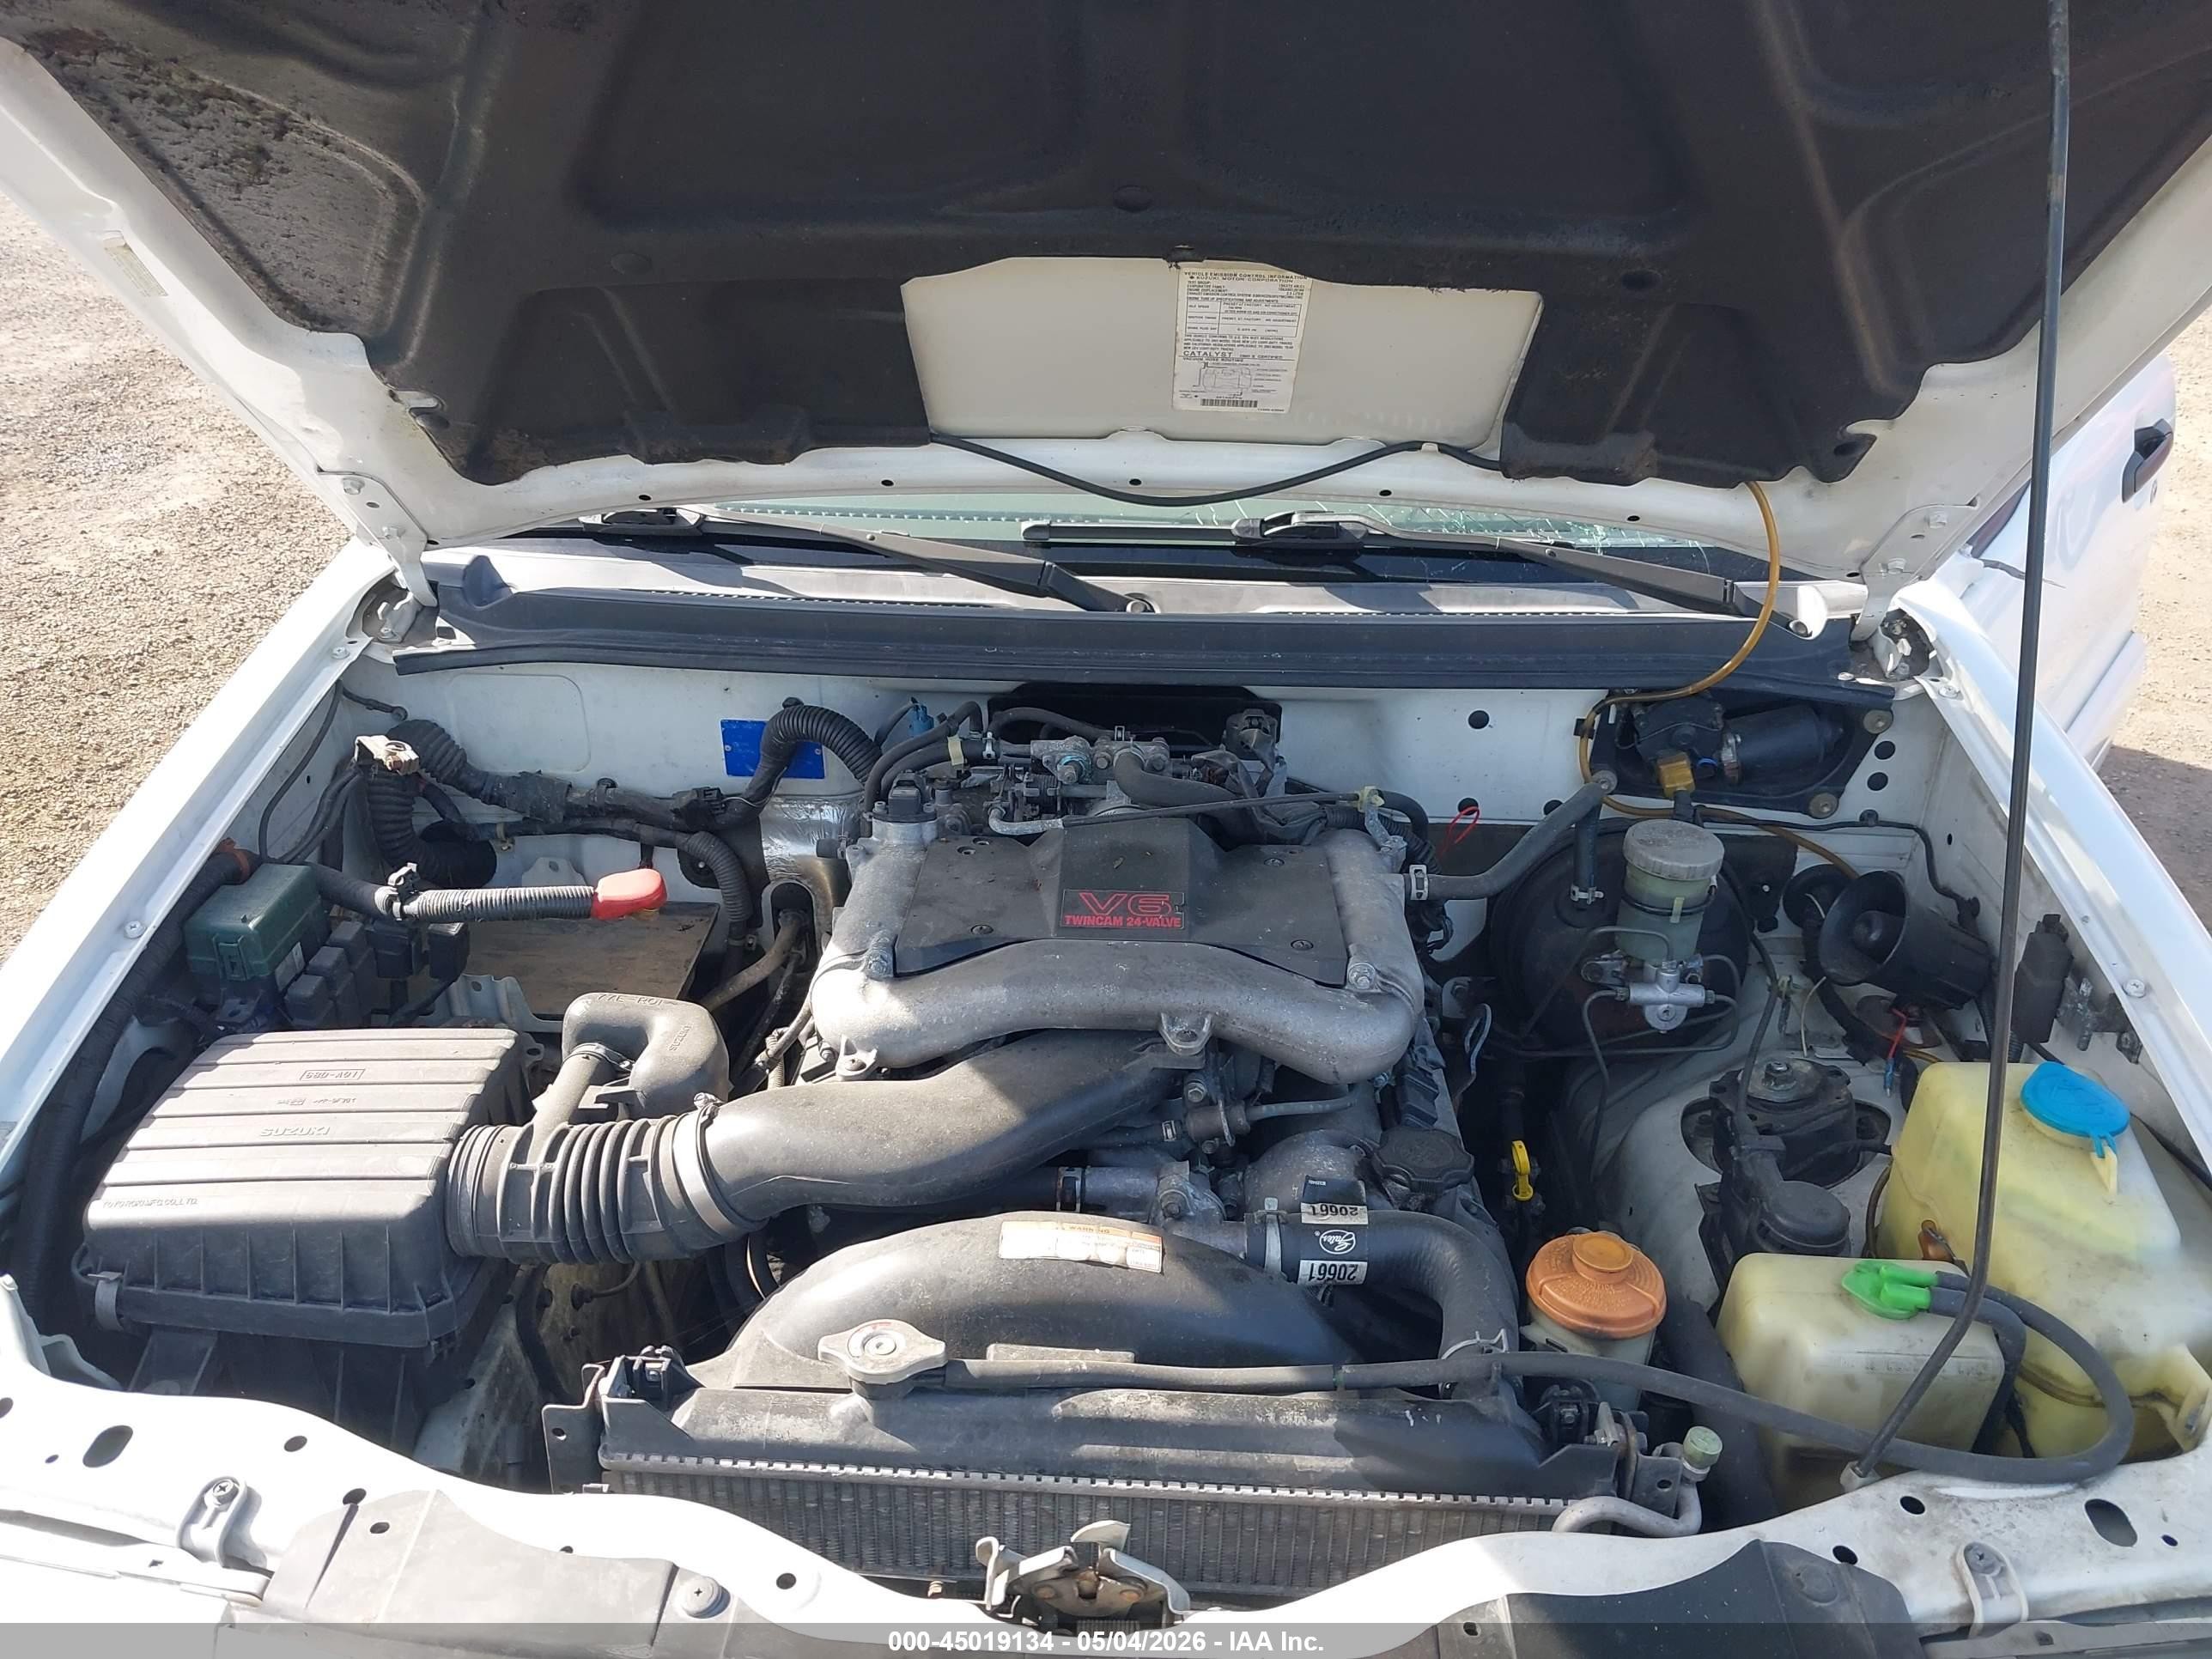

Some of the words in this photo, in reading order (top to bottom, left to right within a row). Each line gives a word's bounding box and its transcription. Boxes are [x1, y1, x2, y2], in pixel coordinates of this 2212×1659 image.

[1079, 892, 1173, 917] V6
[1064, 915, 1124, 927] TWINCAM
[1126, 915, 1182, 928] 24-VALVE
[259, 1125, 331, 1137] SUZUKI
[1310, 1204, 1359, 1217] 20661
[1322, 1231, 1355, 1251] Gates
[1308, 1263, 1358, 1281] 20661
